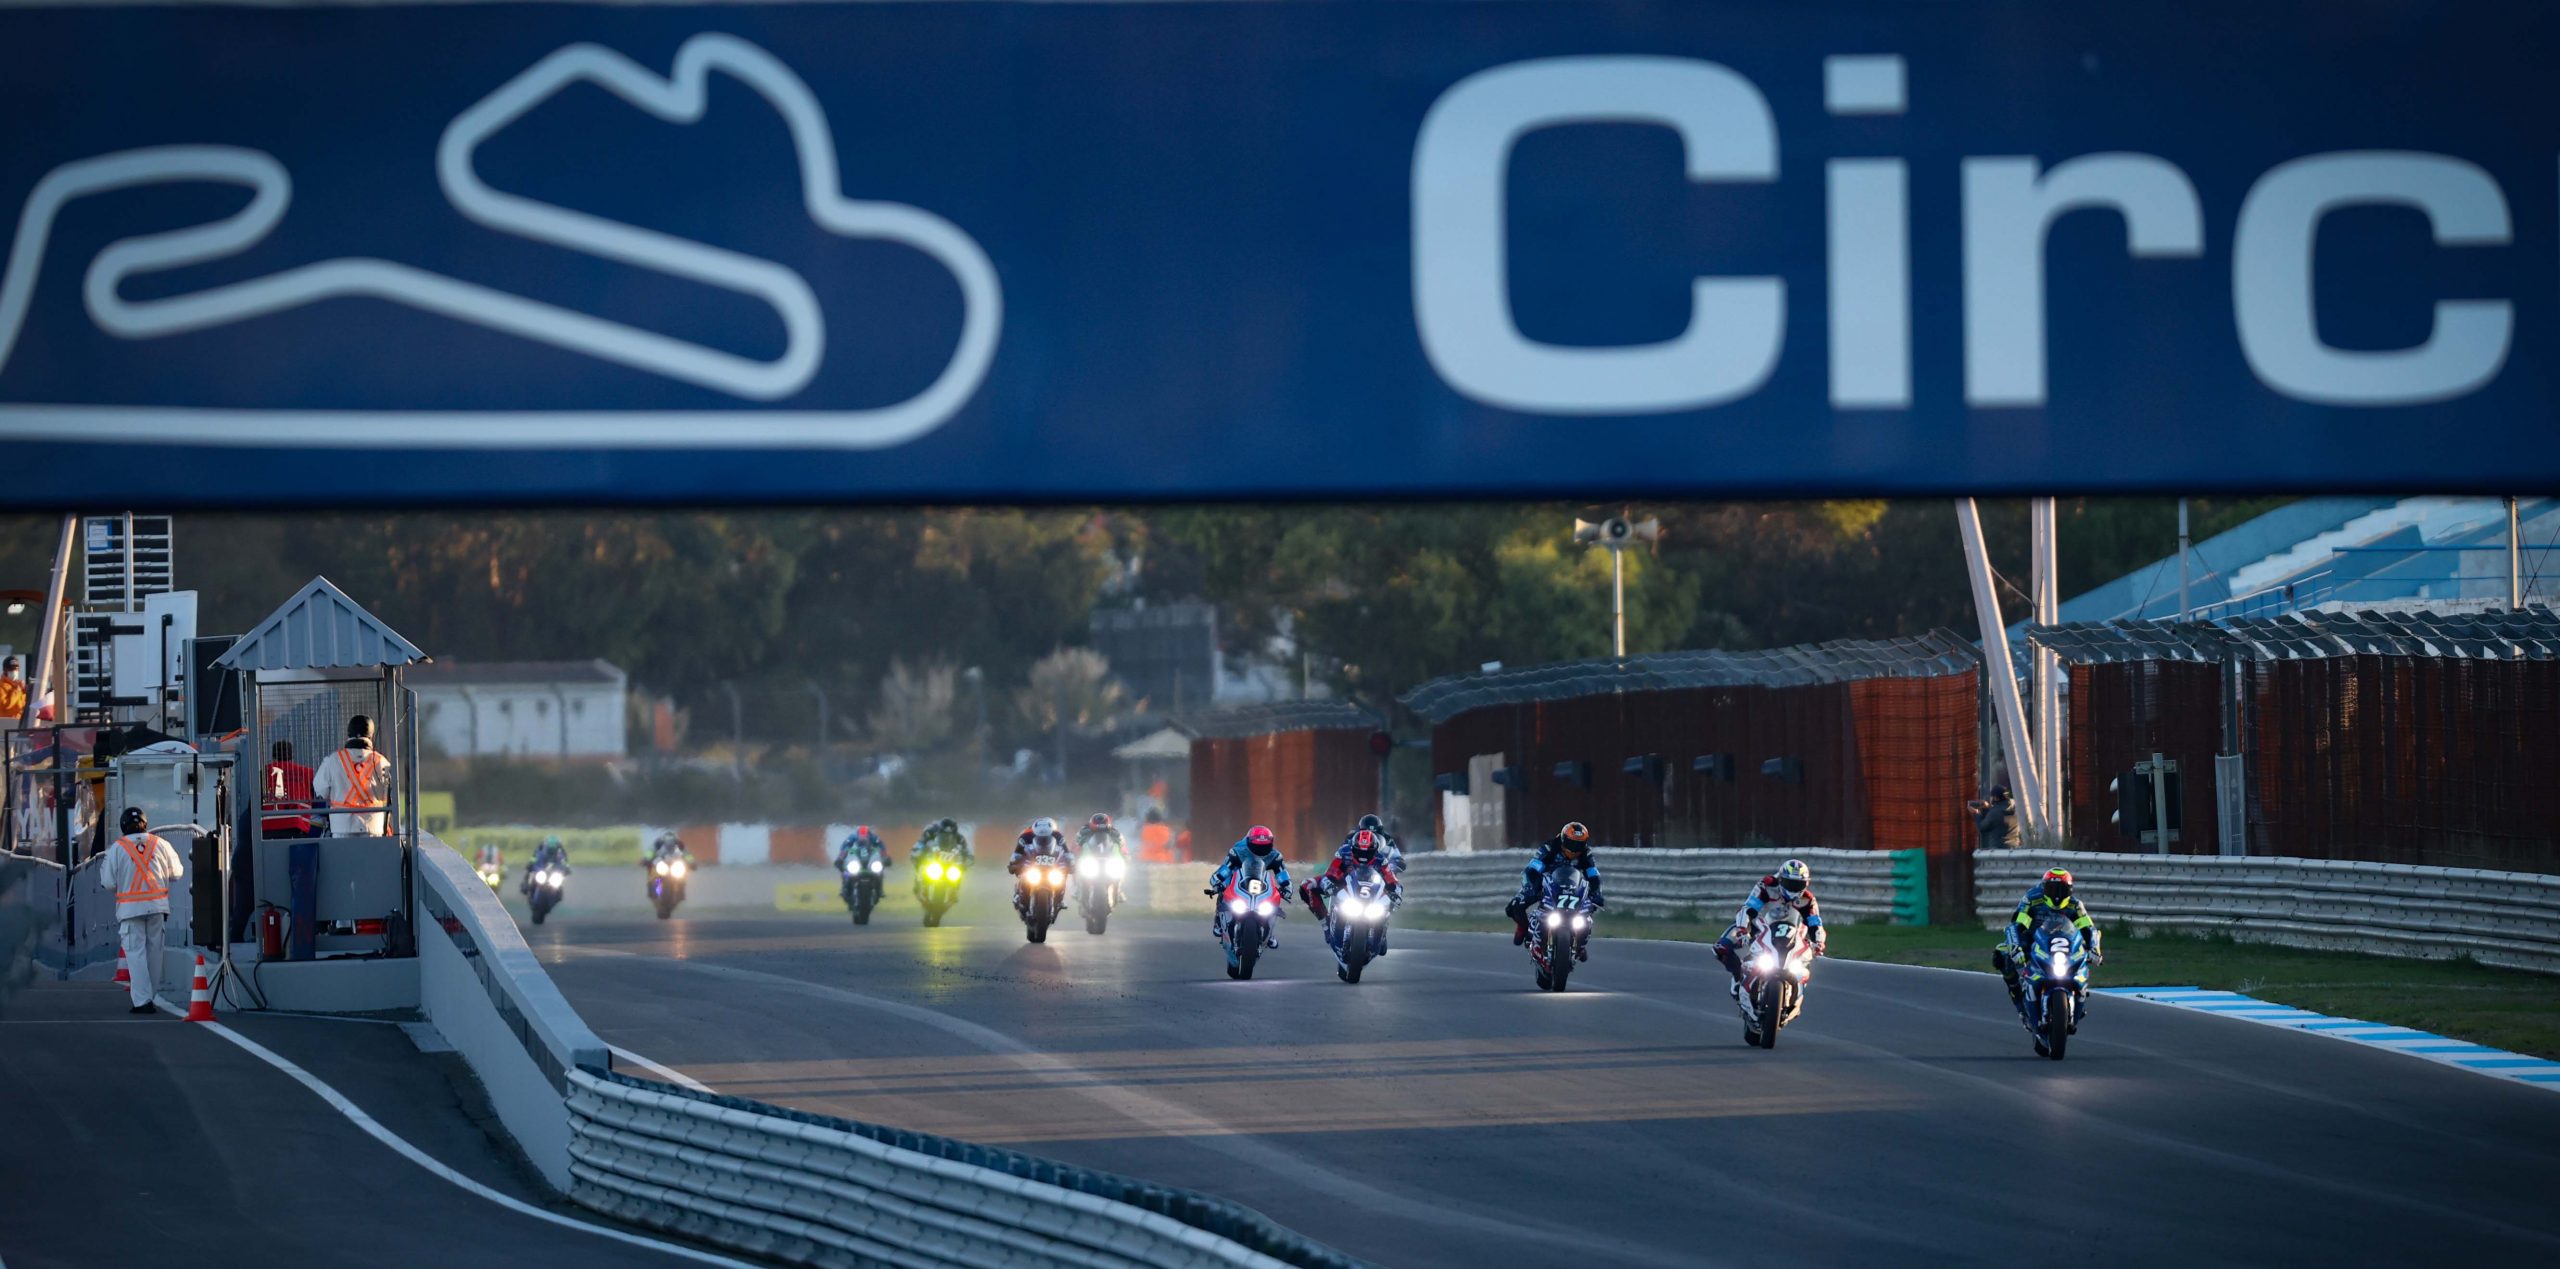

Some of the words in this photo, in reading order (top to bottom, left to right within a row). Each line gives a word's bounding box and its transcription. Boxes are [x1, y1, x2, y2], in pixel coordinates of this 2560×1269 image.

[1410, 54, 2515, 415] Circ
[1035, 855, 1056, 866] 333
[1359, 886, 1371, 899] 5
[1556, 894, 1580, 910] 77
[2050, 937, 2070, 953] 2
